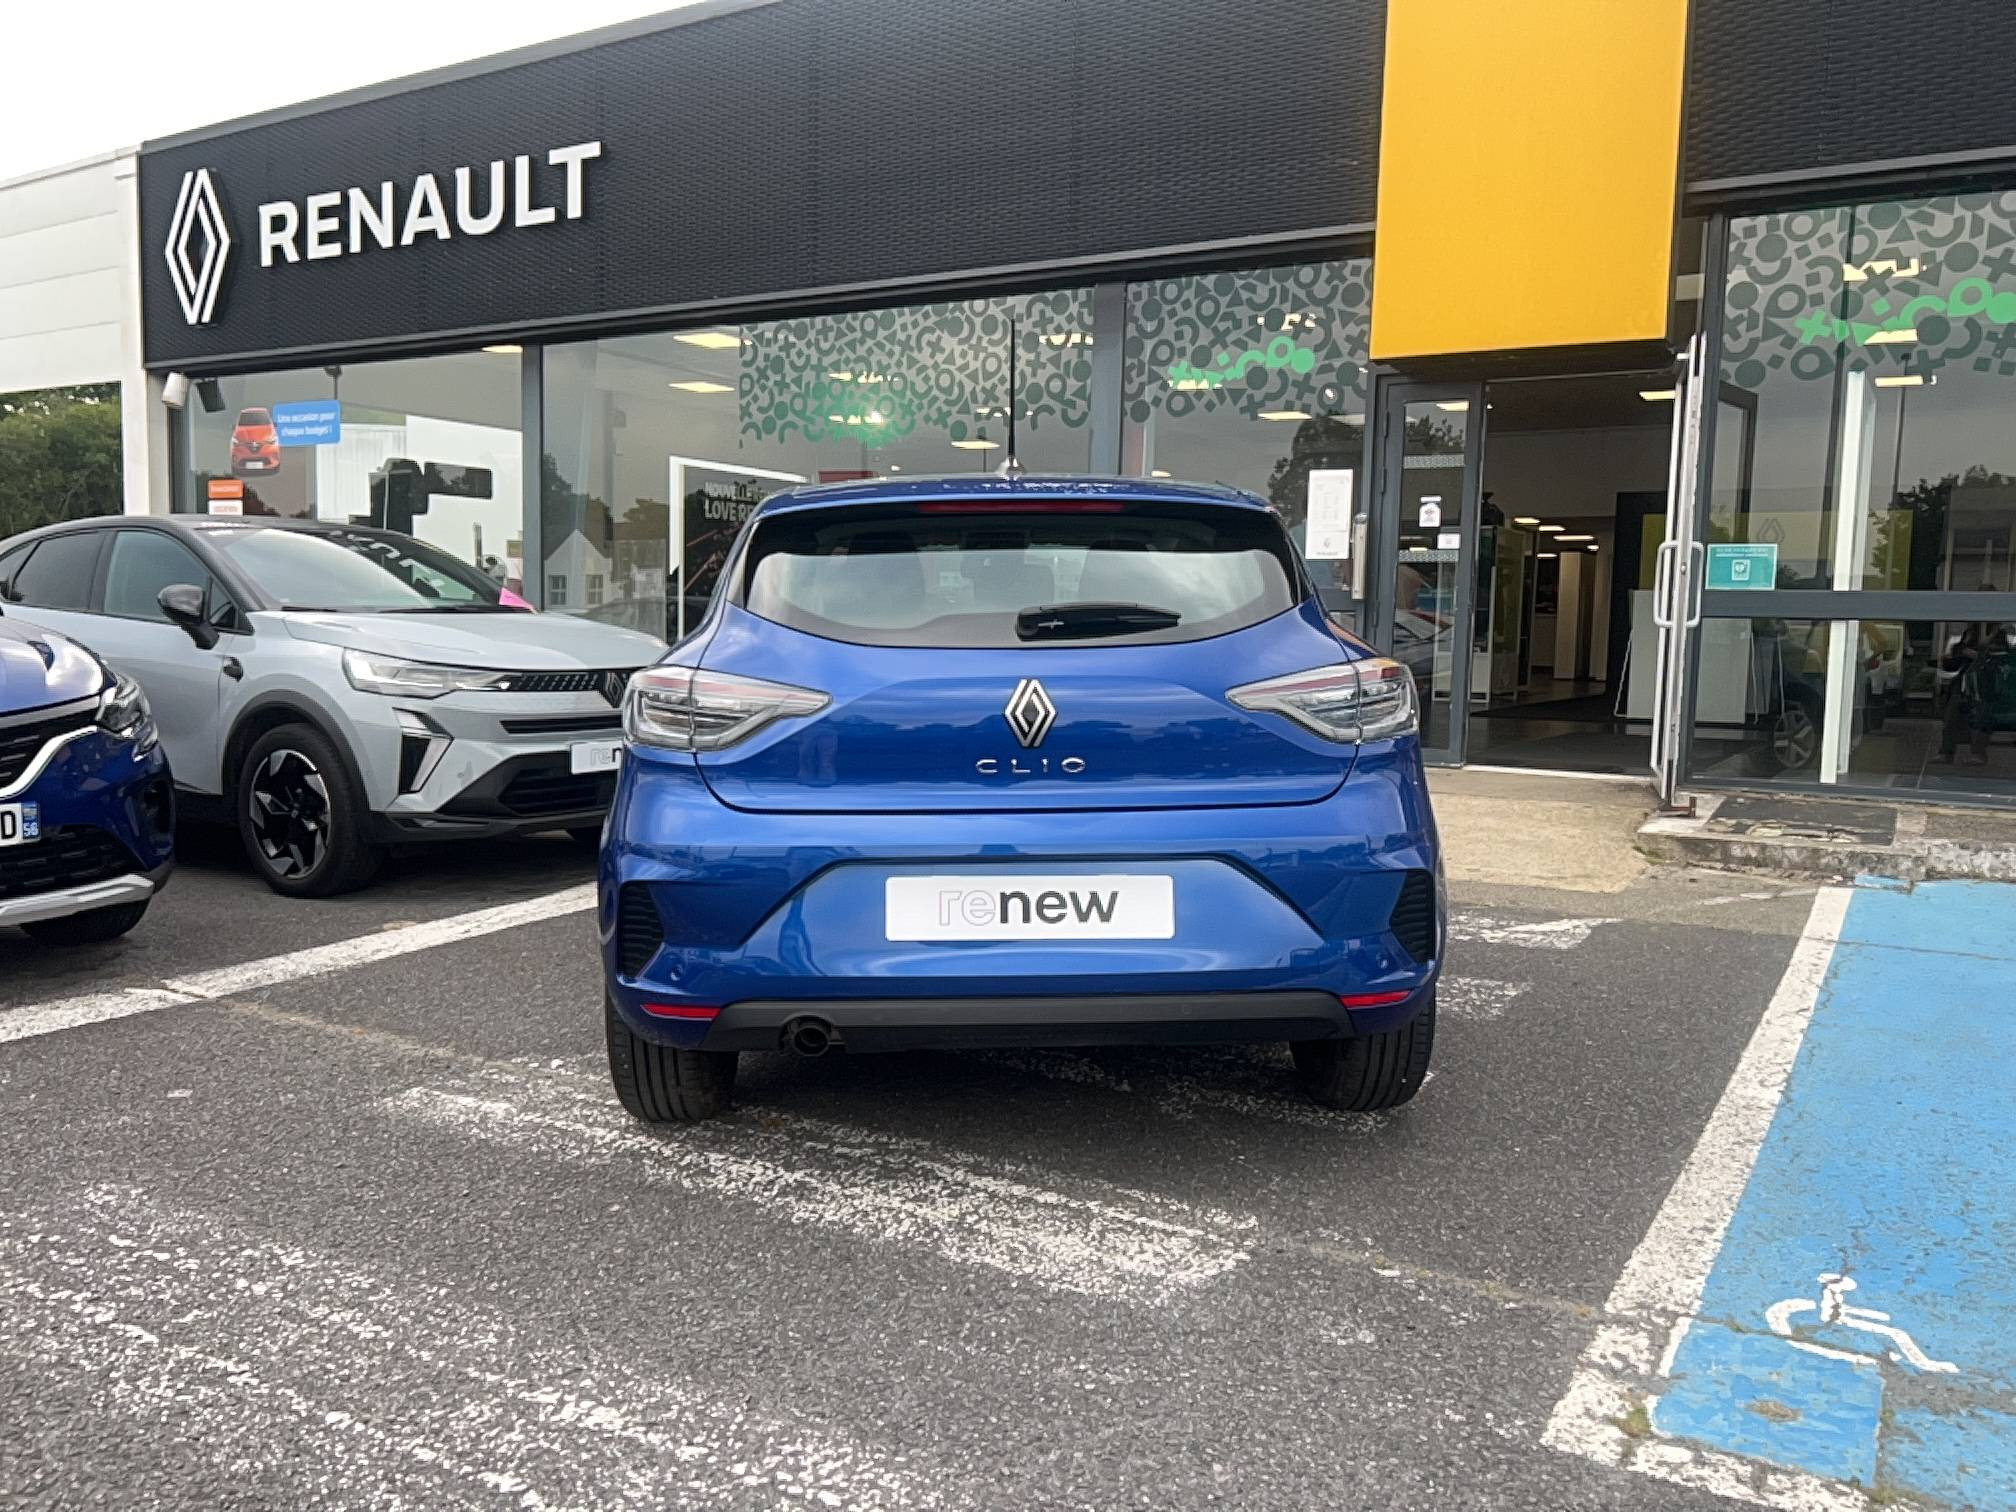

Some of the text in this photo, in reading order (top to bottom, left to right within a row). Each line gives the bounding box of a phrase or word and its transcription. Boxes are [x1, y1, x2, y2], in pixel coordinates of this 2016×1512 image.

[258, 140, 601, 268] RENAULT
[704, 498, 737, 521] LOVE
[975, 756, 1087, 774] CLIO
[938, 889, 1120, 927] renew
